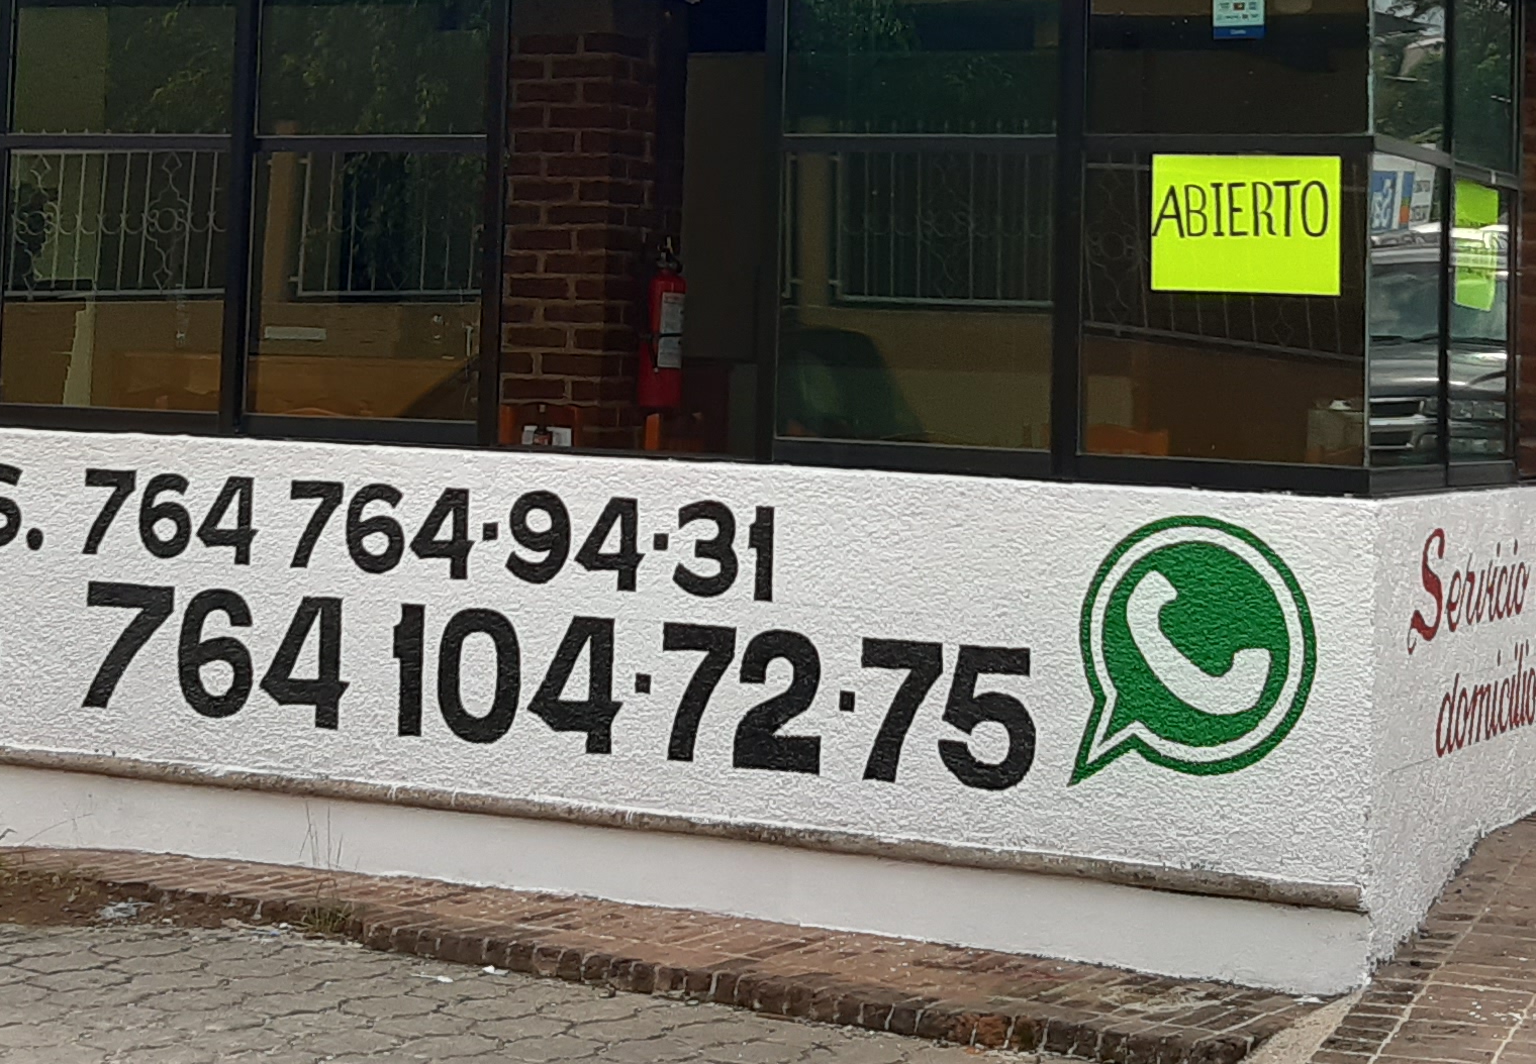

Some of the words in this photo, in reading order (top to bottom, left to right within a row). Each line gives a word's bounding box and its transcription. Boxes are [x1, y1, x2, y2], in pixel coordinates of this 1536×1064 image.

[1152, 180, 1329, 239] ABIERTO
[81, 468, 260, 566] 764
[1407, 528, 1530, 655] Servicio
[81, 581, 350, 731] 764
